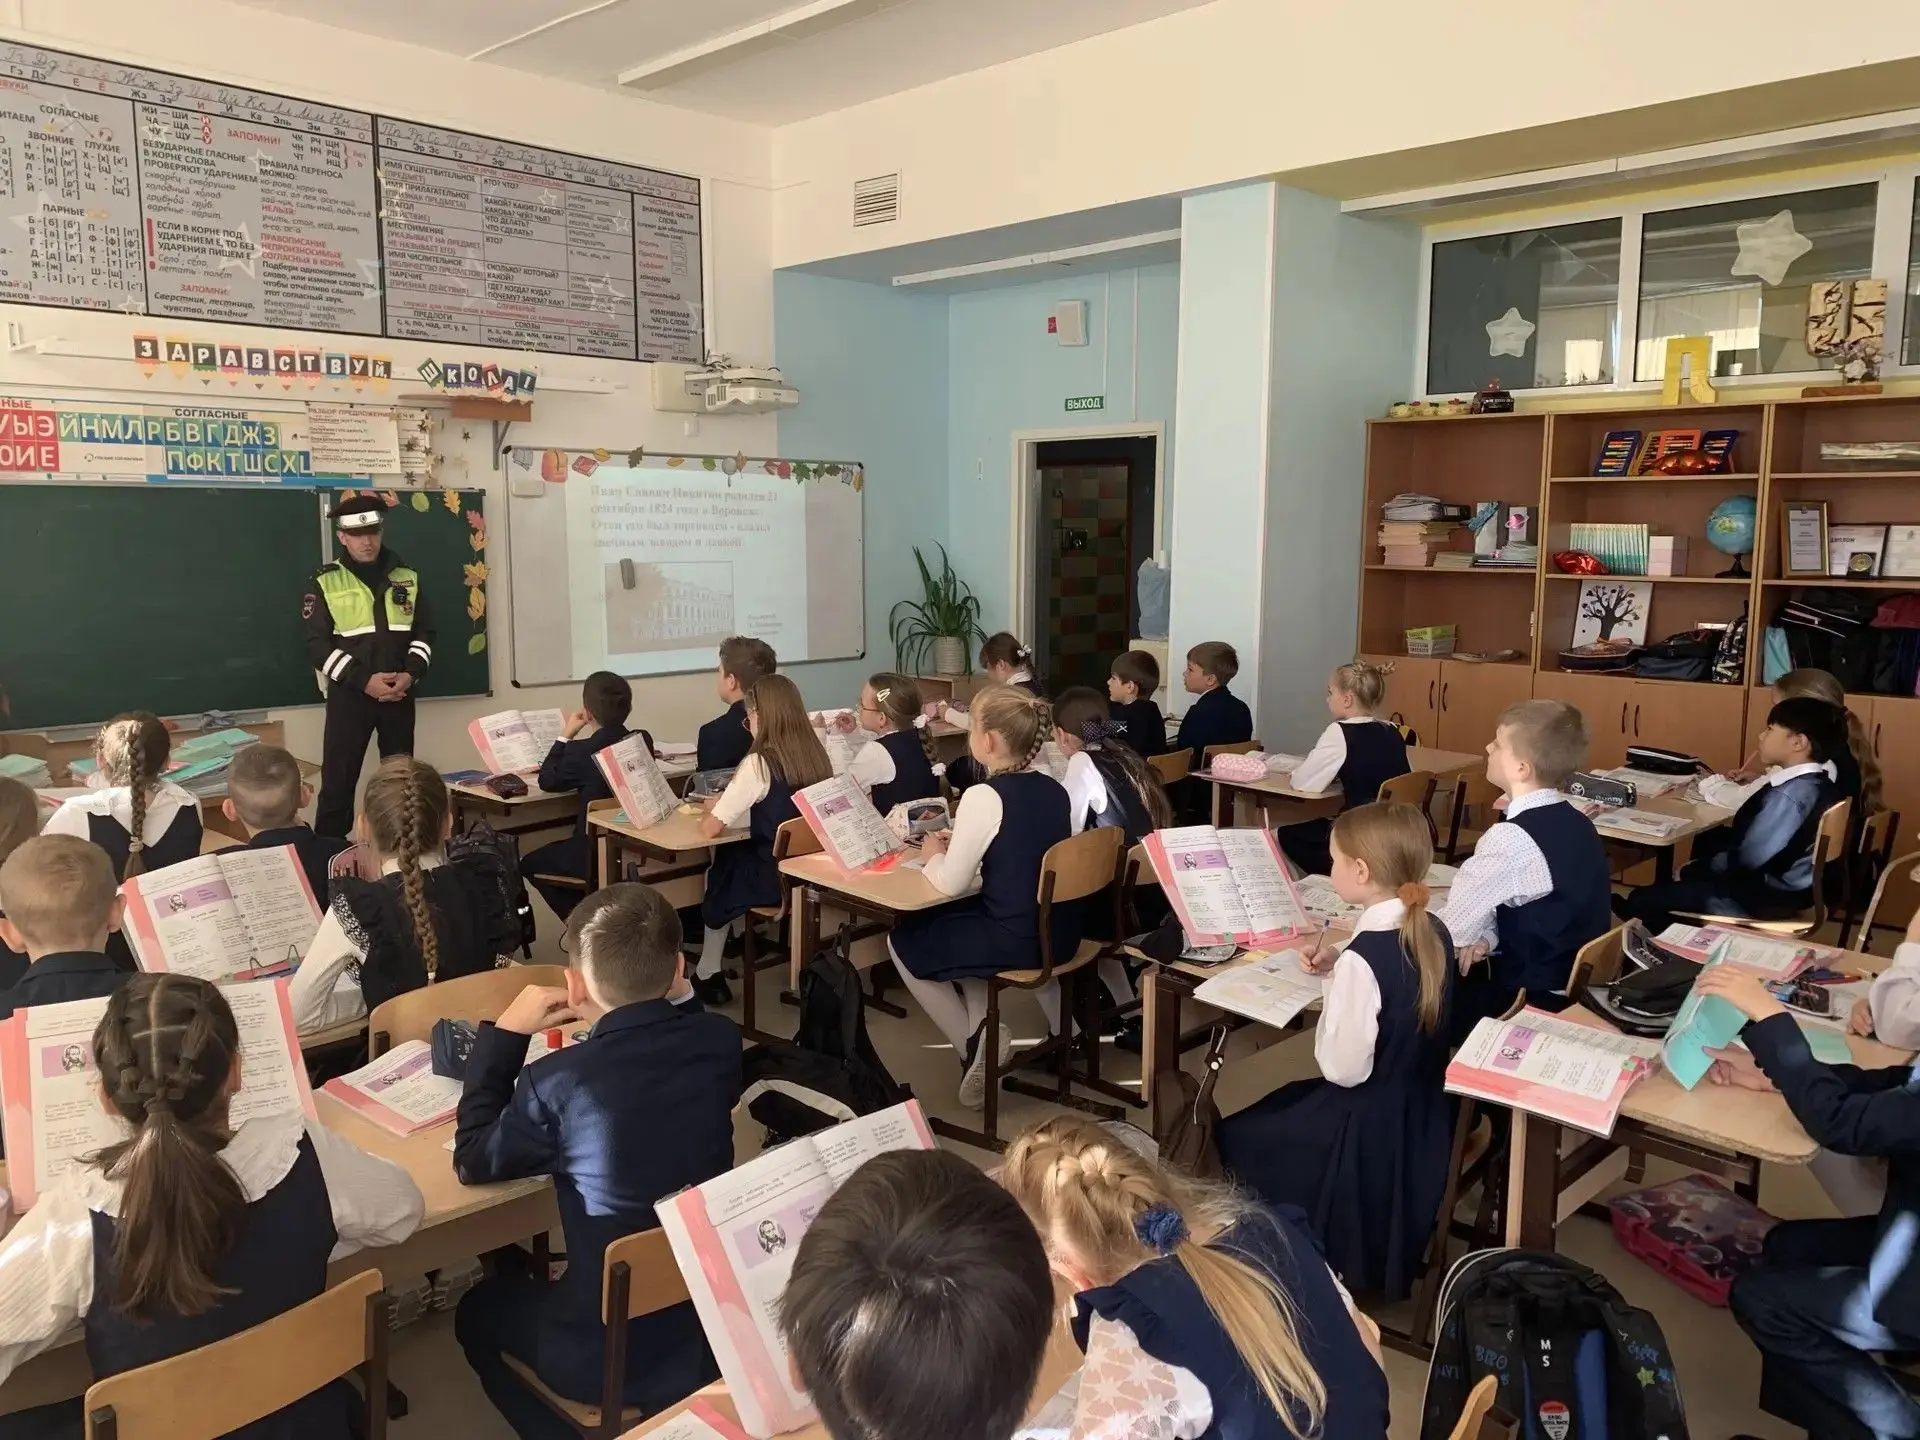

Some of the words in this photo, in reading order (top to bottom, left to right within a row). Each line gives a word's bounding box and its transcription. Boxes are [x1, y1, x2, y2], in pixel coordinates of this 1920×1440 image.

[40, 104, 100, 122] СОГЛАСНЫЕ
[141, 105, 158, 115] ЖИ
[171, 111, 189, 120] ШИ
[173, 122, 190, 131] ЩА
[28, 130, 75, 146] ЗВОНКИЕ
[175, 131, 192, 142] ЩУ
[227, 128, 281, 145] ЗАПОМНИ!
[84, 140, 121, 154] ГЛУХИЕ
[143, 138, 204, 156] БЕЗУДАРНЫЕ
[205, 149, 247, 163] ГЛАСНЫЕ
[143, 148, 150, 157] В
[151, 150, 182, 162] КОРНЕ
[184, 155, 217, 168] СЛОВА
[144, 158, 201, 174] ПРОВЕРЯЮТ
[203, 167, 259, 184] УДАРЕНИЕМ
[259, 158, 300, 172] ПРАВИЛА
[301, 165, 344, 179] ПЕРЕНОСА
[259, 168, 297, 181] МОЖНО:
[384, 159, 403, 170] ИМЯ
[404, 162, 477, 183] СУЩЕСТВИТЕЛЬНОЕ
[405, 182, 471, 201] ПРИЛАГАТЕЛЬНОЕ
[42, 203, 85, 217] ПАРНЫЕ
[385, 199, 415, 210] ГЛАГОЛ
[484, 215, 499, 224] ЧТО
[156, 220, 182, 231] ЕСЛИ
[183, 224, 190, 232] В
[191, 225, 221, 236] КОРНЕ
[222, 229, 243, 241] ПОД
[386, 220, 445, 235] МЕСТОИМЕНИЕ
[485, 224, 500, 233] ЧТО
[156, 231, 214, 245] УДАРЕНИЕМ
[226, 240, 238, 249] ТО
[240, 242, 256, 252] БЕЗ
[156, 241, 207, 254] УДАРЕНИЯ
[208, 248, 245, 260] ПИШЕМ
[407, 252, 464, 267] ЧИСЛИТЕЛЬНОЕ
[389, 270, 423, 281] НАРЕЧИЕ
[413, 309, 453, 321] ПРЕДЛОГИ
[420, 362, 532, 393] ШКОЛА!
[1066, 397, 1101, 410] ВЫХОД
[174, 408, 249, 420] СОГЛАСНЫЕ
[649, 503, 673, 514] 1824
[1540, 1339, 1551, 1350] M
[1542, 1354, 1550, 1367] S
